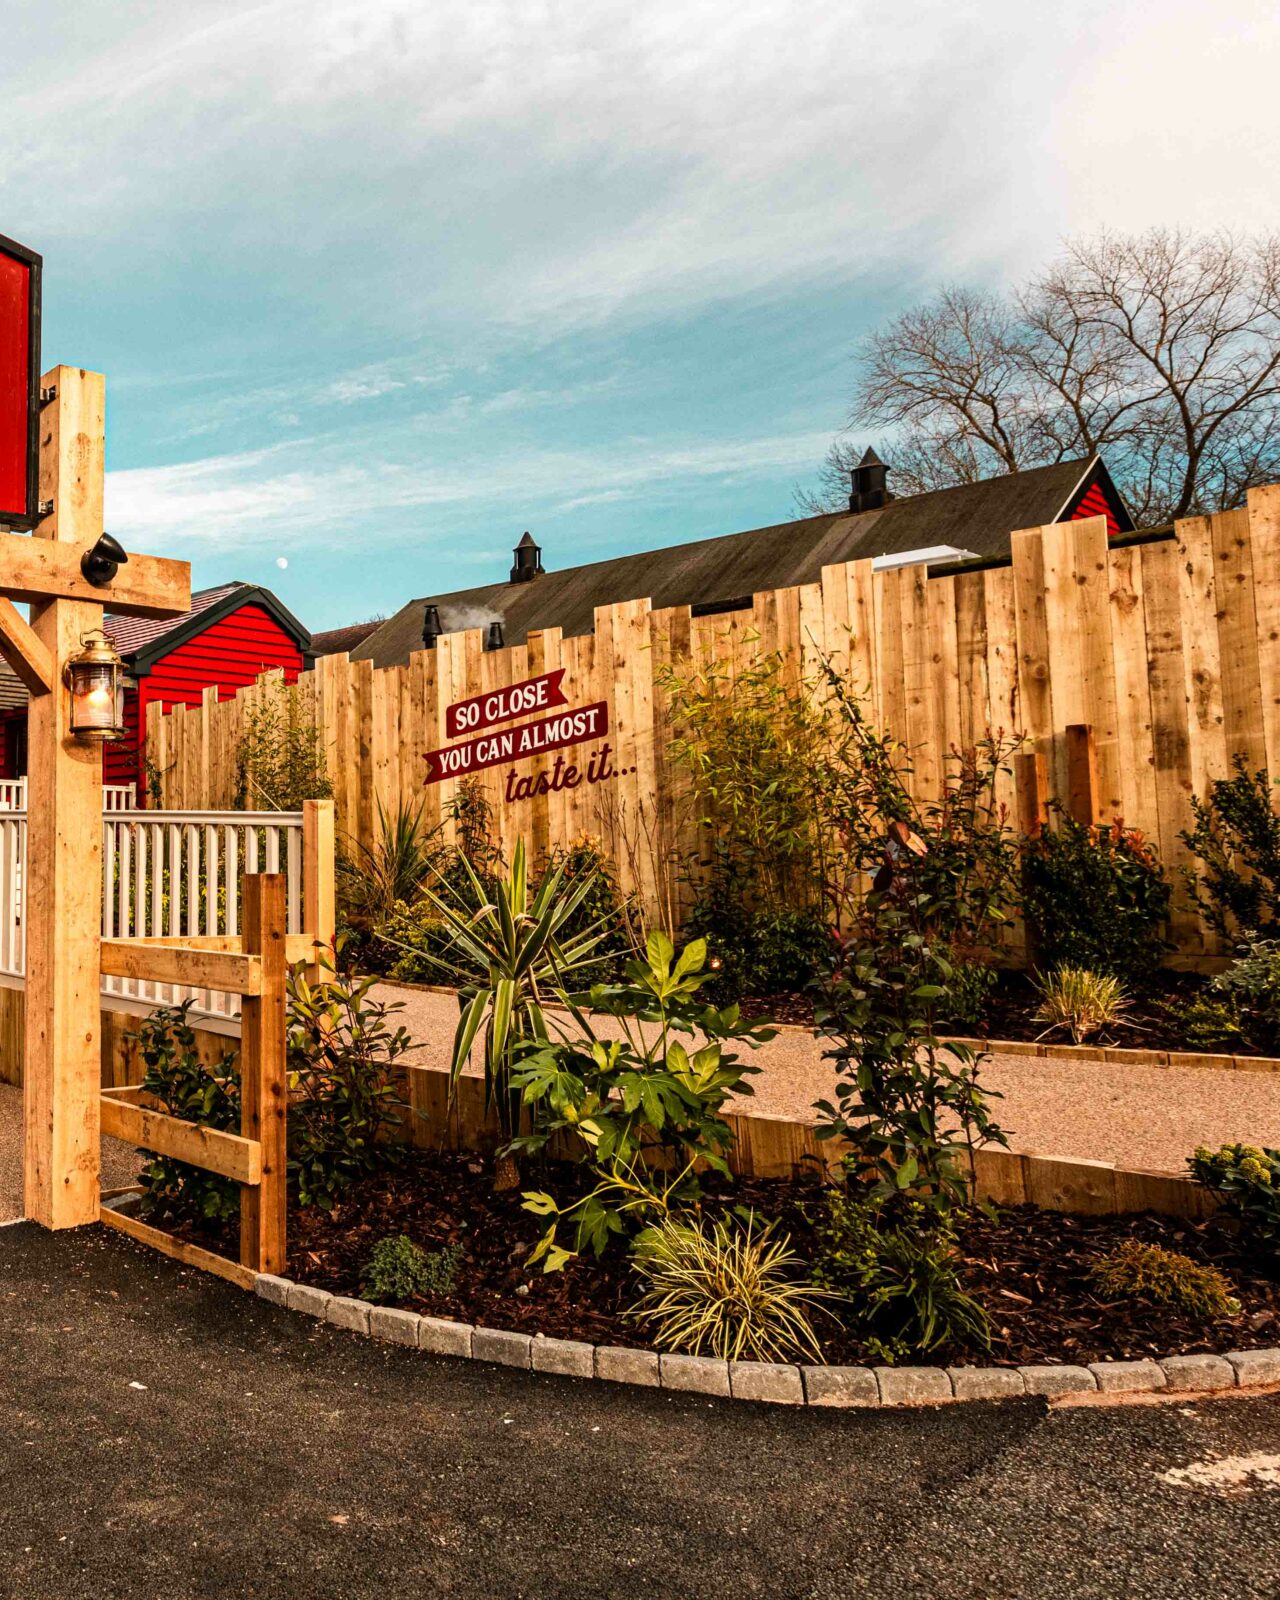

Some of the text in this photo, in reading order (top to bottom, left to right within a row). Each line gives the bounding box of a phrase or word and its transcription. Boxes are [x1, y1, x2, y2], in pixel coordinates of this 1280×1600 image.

[455, 680, 549, 730] SO CLOSE
[438, 709, 599, 774] YOU CAN ALMOST
[505, 743, 636, 803] taste it...
